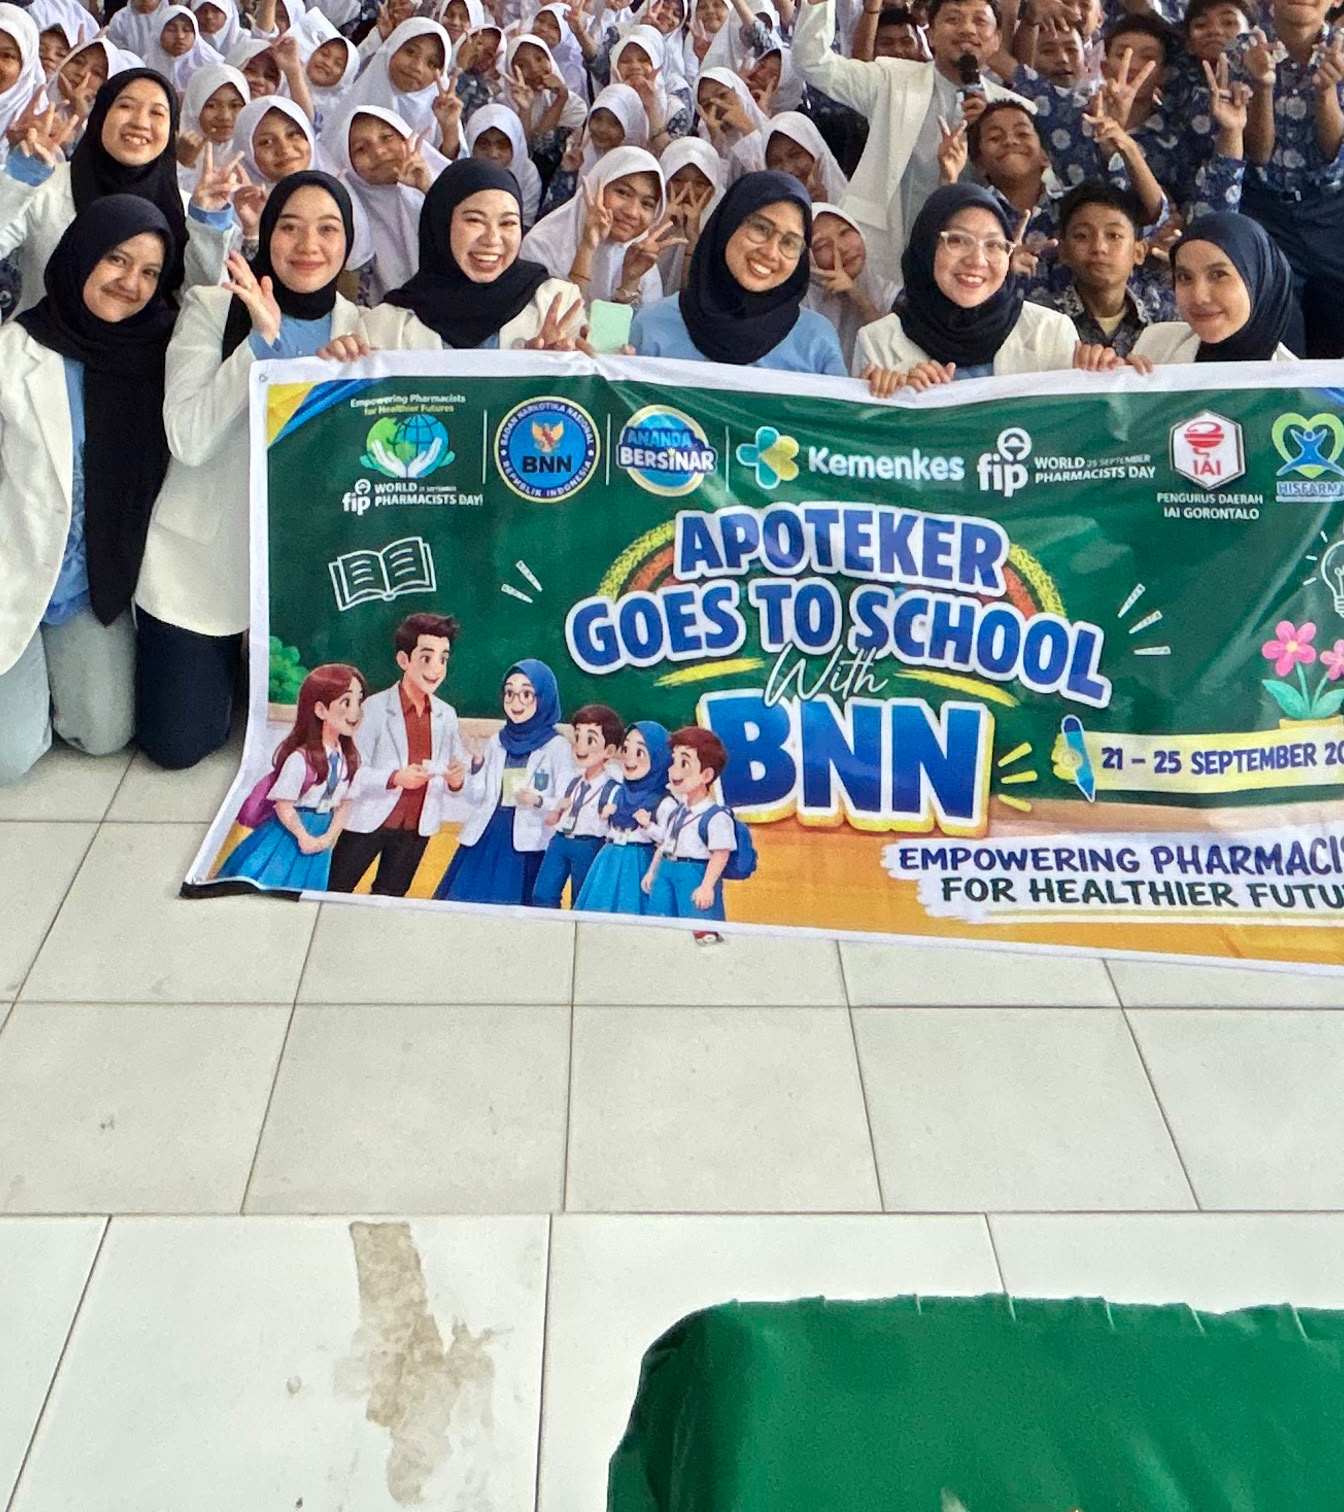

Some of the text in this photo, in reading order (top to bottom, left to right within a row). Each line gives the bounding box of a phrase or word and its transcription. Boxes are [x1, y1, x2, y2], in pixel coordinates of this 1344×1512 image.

[350, 393, 466, 408] Empowering Pharmacists
[364, 404, 455, 416] for Healthier Futures
[500, 402, 594, 446] BADAN NARKOTIKA NASIONAL
[627, 429, 693, 447] ANANDA
[521, 455, 573, 474] BNN
[620, 447, 715, 471] BERSINAR
[808, 447, 965, 481] Kemenkes
[1034, 456, 1085, 470] WORLD
[1193, 460, 1222, 476] IAI
[502, 461, 592, 497] REPUBLIK INDONESIA
[976, 452, 1029, 498] fip
[1035, 466, 1156, 484] PHARMACISTS DAY
[374, 482, 417, 494] WORLD
[1157, 492, 1264, 505] PENGURUS DAERAH
[342, 491, 372, 516] fip
[374, 494, 457, 507] PHARMACISTS
[1164, 507, 1260, 520] IAI GORONTALO
[678, 508, 1006, 592] APOTEKER
[572, 583, 1105, 703] GOES TO SCHOOL
[764, 643, 888, 707] With
[706, 696, 985, 823] BNN
[1101, 746, 1123, 771] 21
[1153, 750, 1182, 774] 25
[1191, 742, 1318, 775] SEPTEMBER
[899, 845, 1140, 874] EMPOWERING
[942, 876, 1016, 904] FOR
[1029, 878, 1237, 909] HEALTHIER
